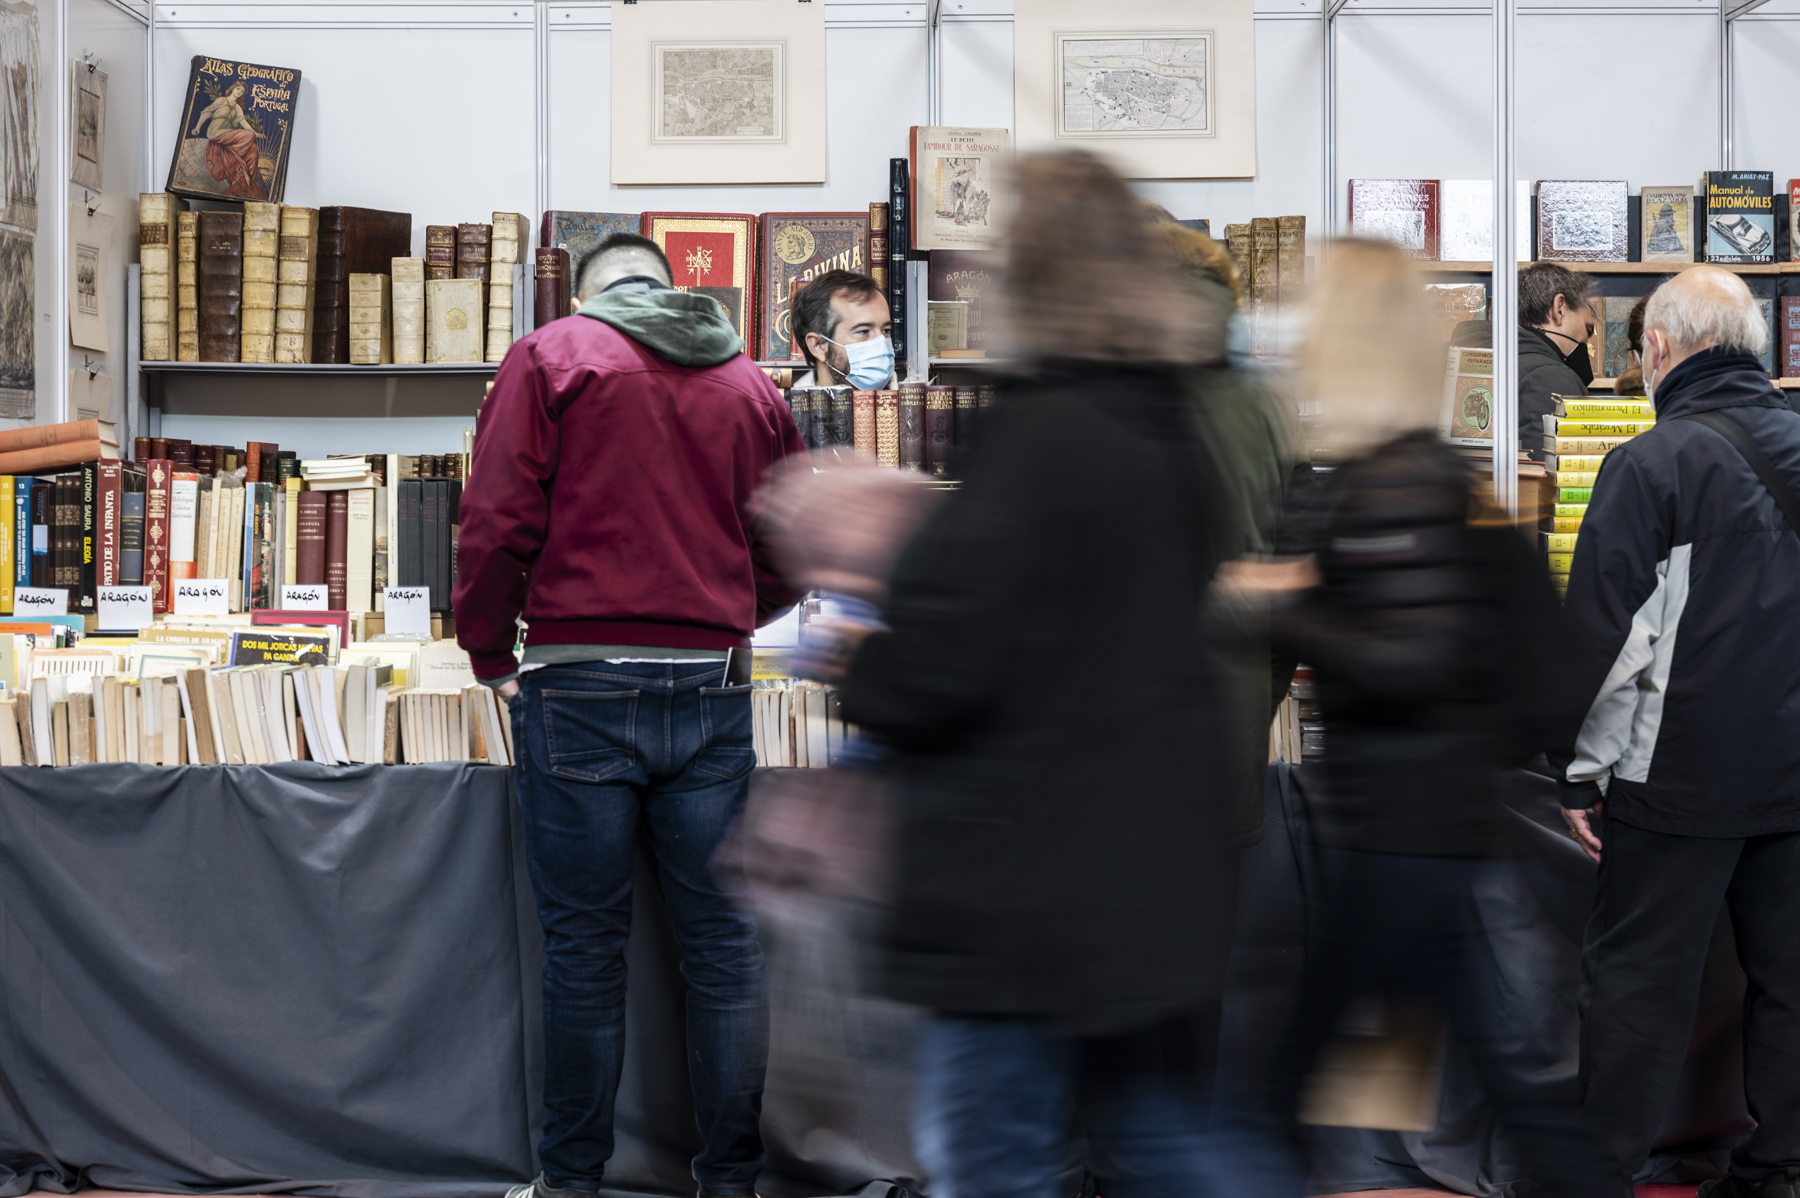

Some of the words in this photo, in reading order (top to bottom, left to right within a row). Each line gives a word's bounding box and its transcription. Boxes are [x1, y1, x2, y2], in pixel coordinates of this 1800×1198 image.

[200, 58, 234, 81] ATLAS
[250, 84, 291, 100] ESPAÑA
[248, 97, 289, 113] PORTUGAL
[923, 142, 952, 151] TAMBOUR
[954, 143, 963, 151] DE
[966, 144, 1001, 153] SARAGOSSE
[1710, 184, 1744, 195] Manual
[1745, 185, 1755, 195] de
[1710, 195, 1772, 209] AUTOMÓVILES
[804, 245, 862, 282] DIVINA
[946, 270, 992, 284] ARAGÓN
[1573, 405, 1628, 414] Prerrománico
[1632, 406, 1640, 414] El
[1580, 424, 1622, 433] Mozárabe
[1627, 424, 1636, 433] El
[105, 490, 114, 530] INFANTA
[84, 504, 92, 531] SAURA
[105, 532, 113, 545] LA
[83, 537, 92, 564] ELEGÍA
[104, 547, 113, 560] DE
[104, 561, 113, 586] PATIO
[100, 591, 148, 606] ARAGÓN
[286, 590, 320, 604] ARAGÓN
[388, 589, 422, 604] ARAGÓN
[242, 640, 257, 649] DOS
[258, 641, 269, 650] MIL
[270, 642, 297, 651] JOTICAS
[263, 652, 272, 660] PA
